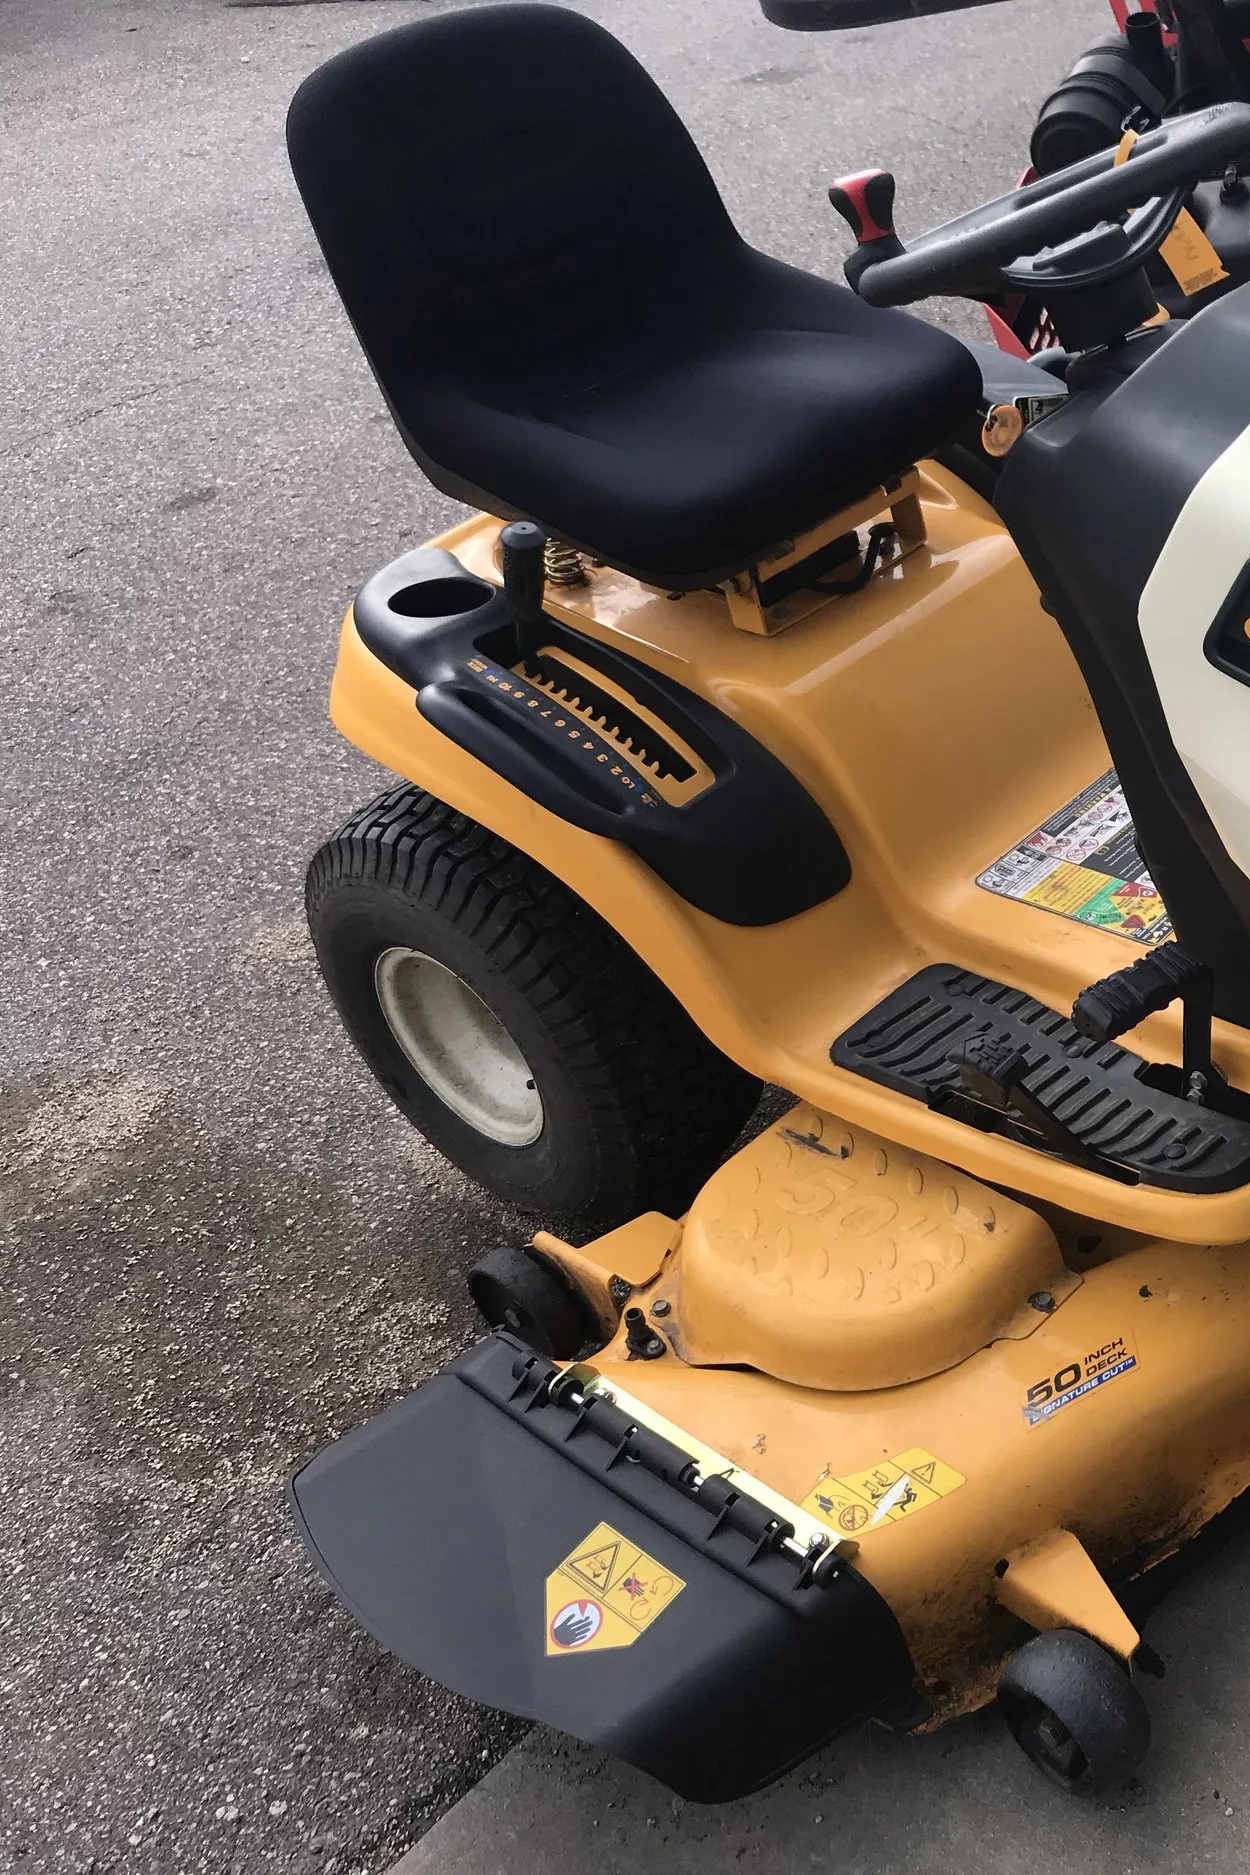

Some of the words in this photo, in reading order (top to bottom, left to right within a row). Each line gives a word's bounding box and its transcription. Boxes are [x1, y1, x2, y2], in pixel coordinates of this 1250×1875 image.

[498, 682, 513, 691] 10
[513, 691, 525, 699] 9
[527, 699, 539, 708] 8
[539, 710, 552, 718] 7
[554, 719, 567, 728] 6
[567, 730, 581, 738] 5
[582, 741, 595, 750] 4
[596, 753, 609, 763] 3
[610, 765, 624, 776] 2
[621, 776, 636, 789] LO
[1084, 1337, 1123, 1366] INCH
[1086, 1347, 1128, 1377] DECK
[1026, 1363, 1081, 1408] 50
